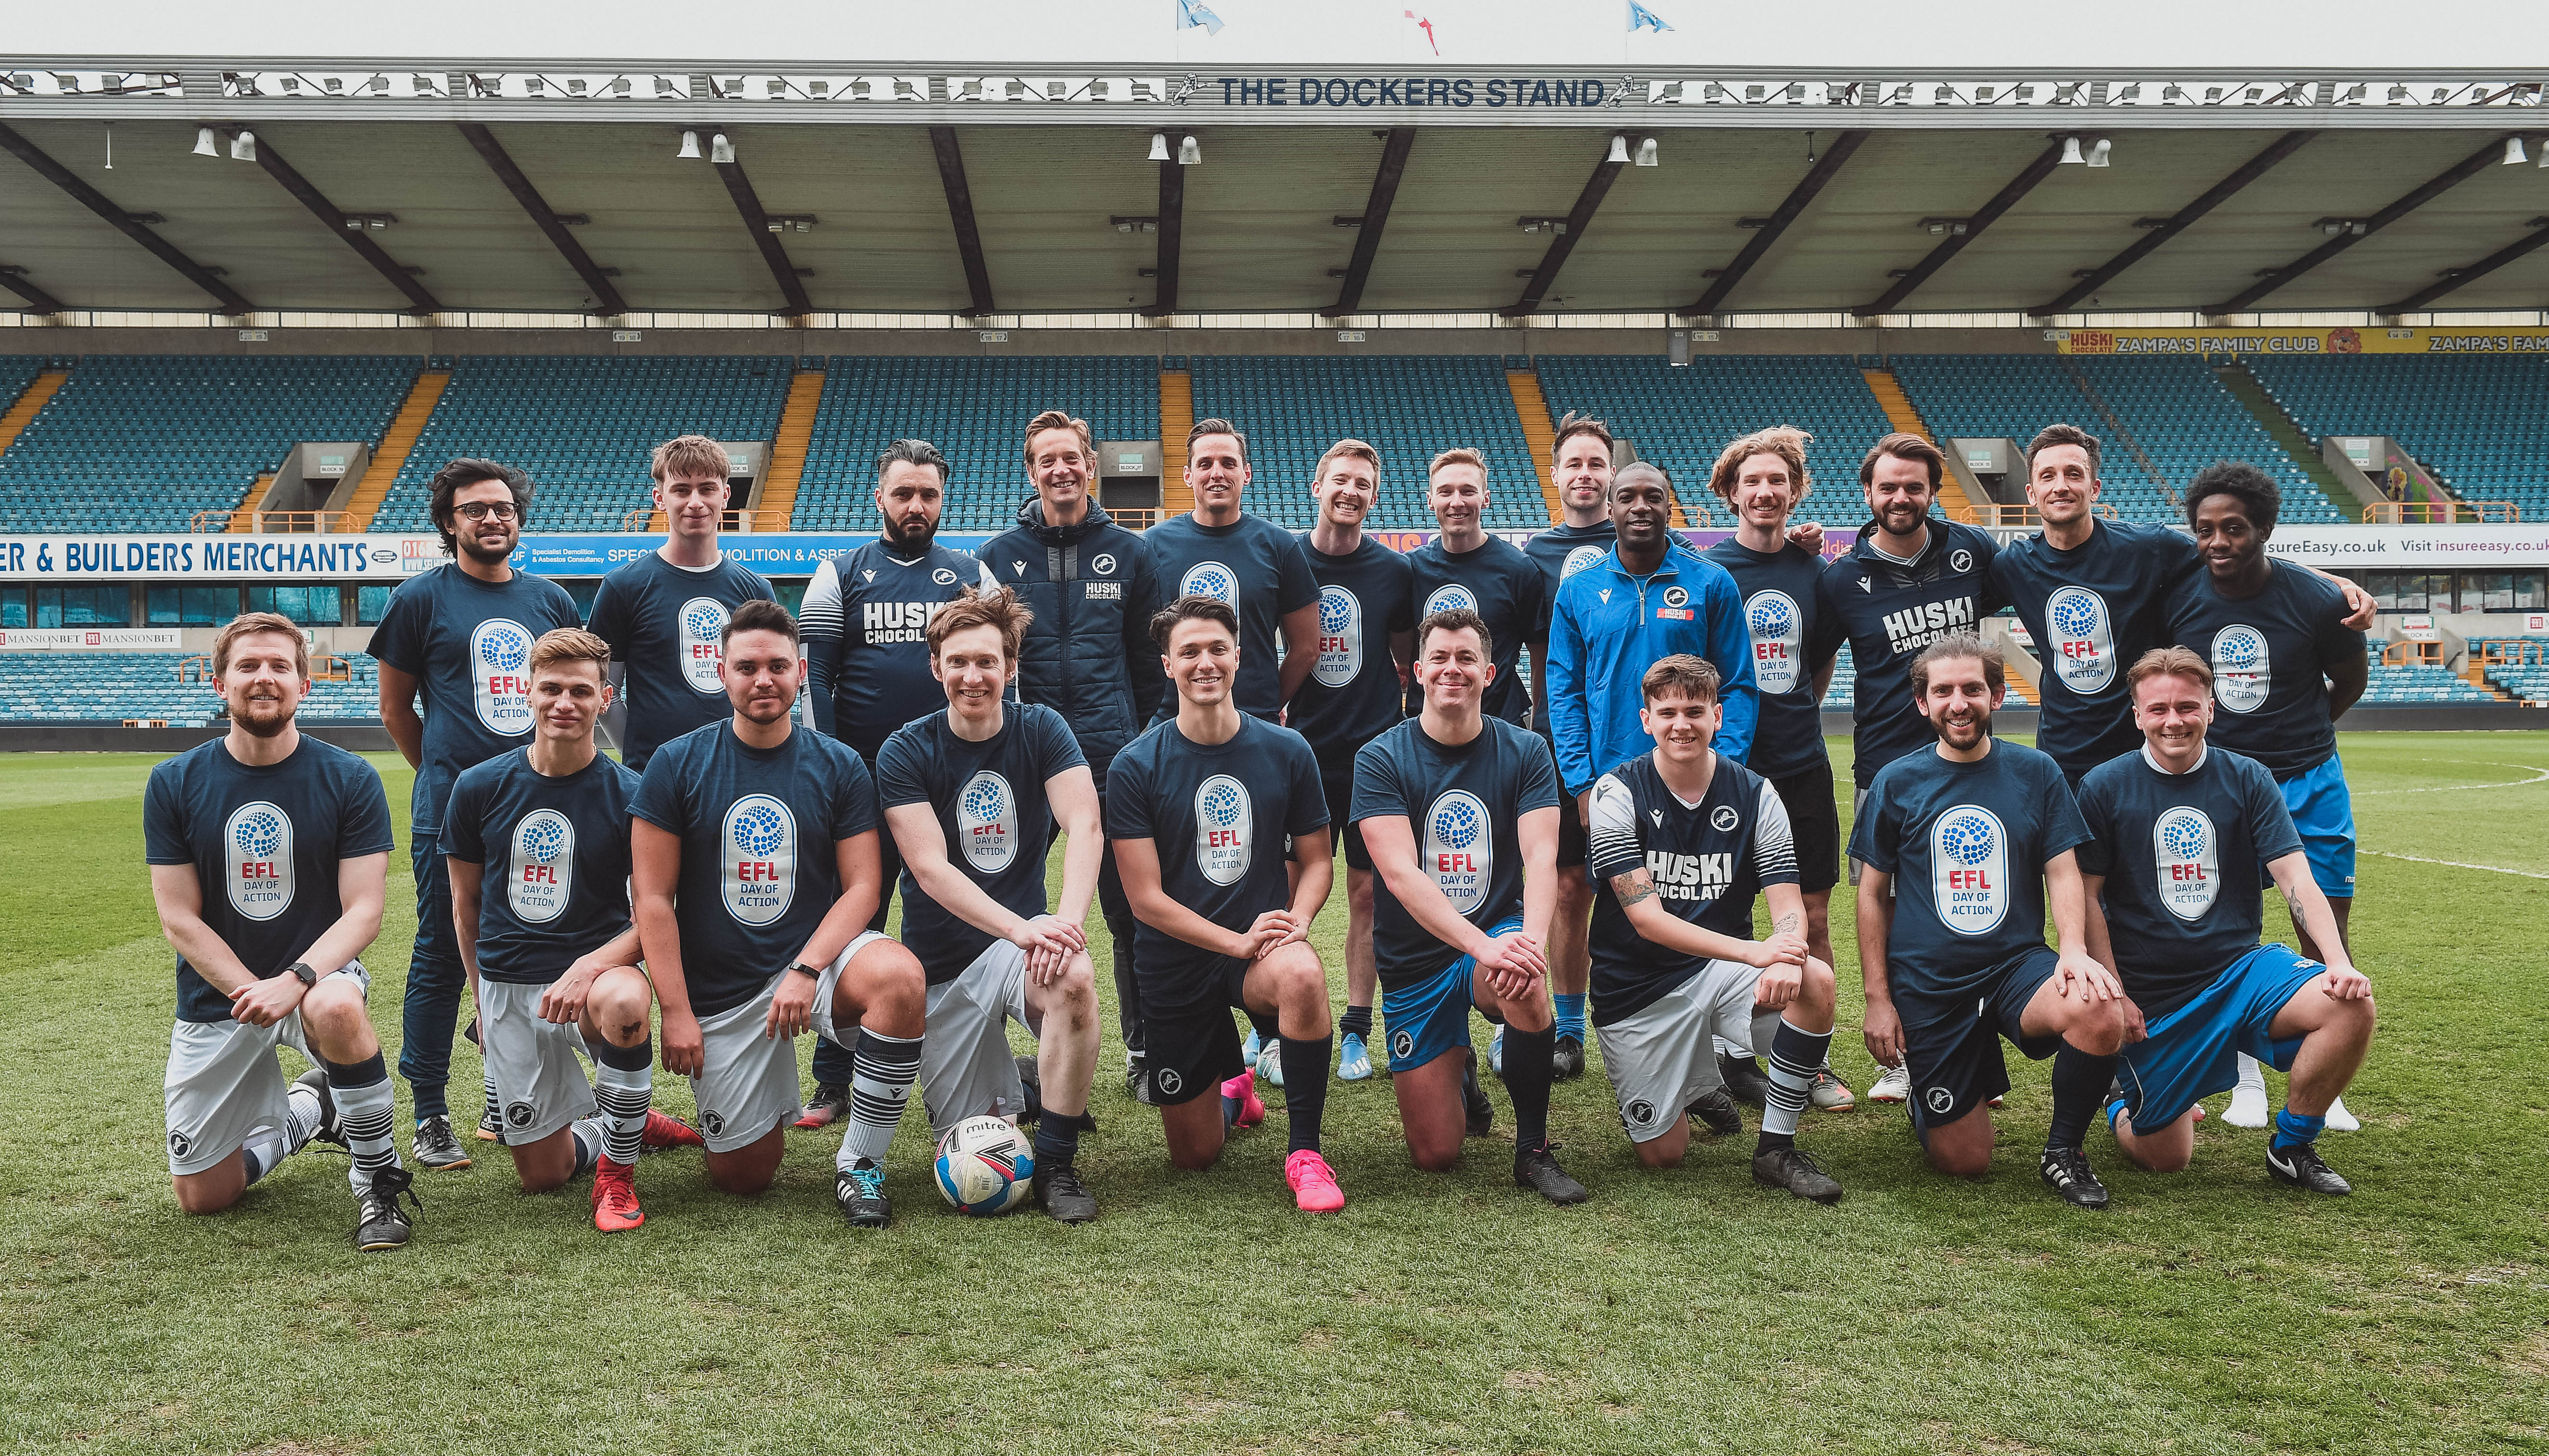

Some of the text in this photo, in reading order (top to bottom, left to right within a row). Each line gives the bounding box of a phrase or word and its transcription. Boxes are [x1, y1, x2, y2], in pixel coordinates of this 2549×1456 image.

[1217, 78, 1604, 107] THE DOCKERS STAND
[2071, 333, 2113, 346] HUSKI
[2116, 337, 2319, 352] ZAMPA'S FAMILY CLUB
[2429, 336, 2509, 351] ZAMPA'S
[2401, 539, 2549, 554] Visit insureeasy.co.uk
[37, 543, 54, 571] &
[66, 543, 193, 572] BUILDERS
[204, 543, 367, 572] MERCHANTS
[719, 548, 790, 561] MOLITION
[794, 548, 805, 561] &
[1086, 582, 1121, 594] HUSKI
[864, 602, 949, 630] HUSK
[1664, 608, 1686, 617] HUSKI
[1882, 596, 1974, 641] HUSKI
[8, 634, 80, 643] MANSIONBET
[102, 634, 175, 643] MANSIONBET
[865, 629, 929, 644] CHOCOL
[1319, 637, 1349, 652] EFL
[2063, 641, 2099, 658] EFL
[693, 645, 722, 658] EFL
[1756, 643, 1787, 659] EFL
[1320, 664, 1350, 672] ACTION
[1760, 661, 1788, 670] DAY OF
[2069, 659, 2100, 669] DAY OF
[1760, 672, 1791, 682] ACTION
[2069, 669, 2104, 679] ACTION
[489, 676, 526, 694] EFL
[2229, 680, 2245, 688] DAY
[2226, 689, 2256, 698] ACTION
[494, 696, 526, 706] DAY OF
[492, 709, 529, 719] ACTION
[973, 823, 1005, 836] EFL
[1209, 830, 1241, 848] EFL
[975, 847, 1006, 856] ACTION
[1212, 849, 1241, 859] DAY OF
[1211, 860, 1241, 870] ACTION
[1438, 854, 1477, 872] EFL
[1646, 850, 1732, 885] HUSKI
[242, 862, 280, 879] EFL
[524, 864, 557, 884] EFL
[739, 862, 778, 881] EFL
[2172, 863, 2206, 881] EFL
[244, 880, 279, 890] DAY OF
[1441, 875, 1476, 885] DAY OF
[1950, 871, 1991, 889] EFL
[523, 885, 555, 895] DAY OF
[740, 884, 778, 894] DAY OF
[2175, 883, 2206, 892] DAY OF
[243, 892, 281, 903] ACTION
[520, 896, 555, 907] ACTION
[738, 897, 779, 907] ACTION
[1953, 892, 1990, 902] DAY OF
[2175, 894, 2209, 903] ACTION
[1951, 905, 1993, 915] ACTION
[967, 1122, 1006, 1134] mitre
